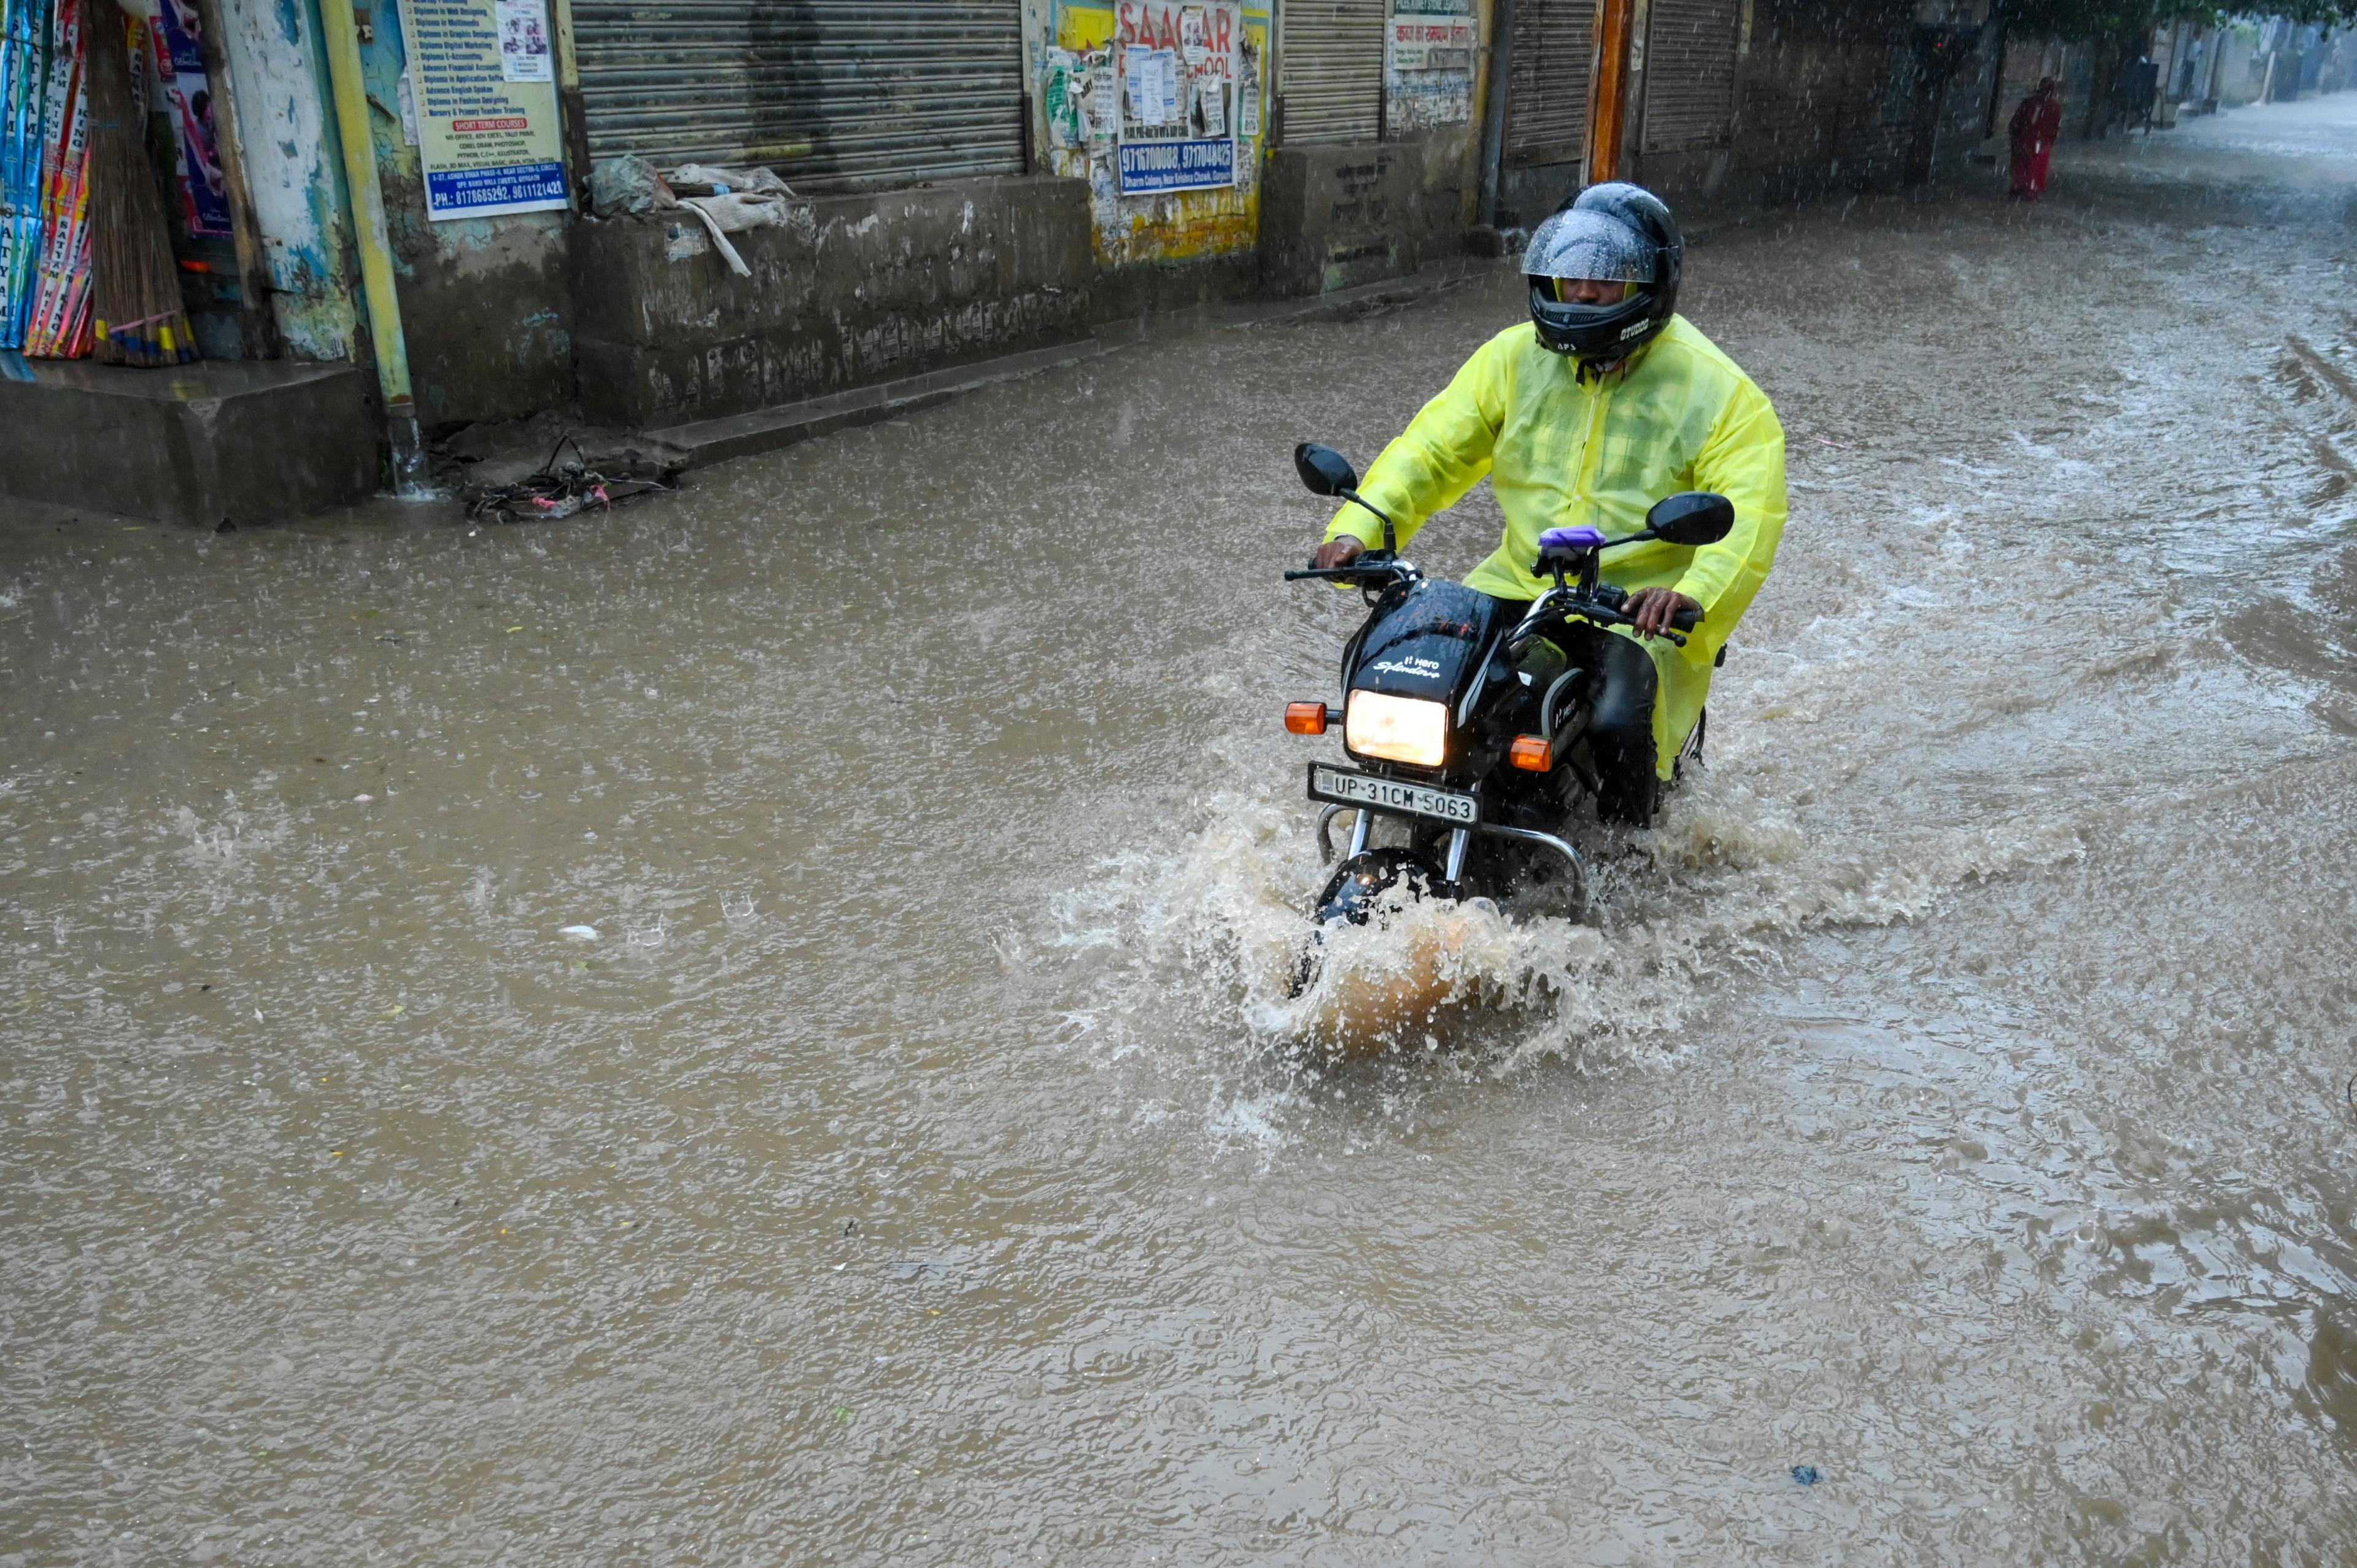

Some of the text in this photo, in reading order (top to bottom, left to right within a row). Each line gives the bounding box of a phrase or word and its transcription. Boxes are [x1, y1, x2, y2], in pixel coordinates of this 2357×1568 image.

[416, 18, 439, 27] Diploma
[1119, 2, 1231, 53] SAAAR
[417, 30, 441, 39] Diploma
[449, 30, 471, 39] Graphic
[444, 42, 463, 50] Digital
[464, 42, 492, 50] Marketing
[424, 75, 447, 84] Diploma
[456, 75, 487, 83] Application
[452, 86, 472, 95] English
[474, 85, 493, 94] Spoken
[427, 98, 451, 106] Diploma
[482, 96, 509, 105] Designing
[429, 109, 451, 117] Nursery
[459, 108, 479, 117] Primary
[504, 106, 525, 115] Training
[72, 109, 88, 148] KING
[455, 119, 525, 130] SHORT TERM COURSES
[1124, 176, 1144, 187] Dharm
[1175, 172, 1193, 183] Krishna
[456, 186, 511, 206] 8178685292,
[513, 180, 563, 199] 9811121428
[1414, 658, 1439, 670] Hero
[1423, 794, 1471, 819] 5063
